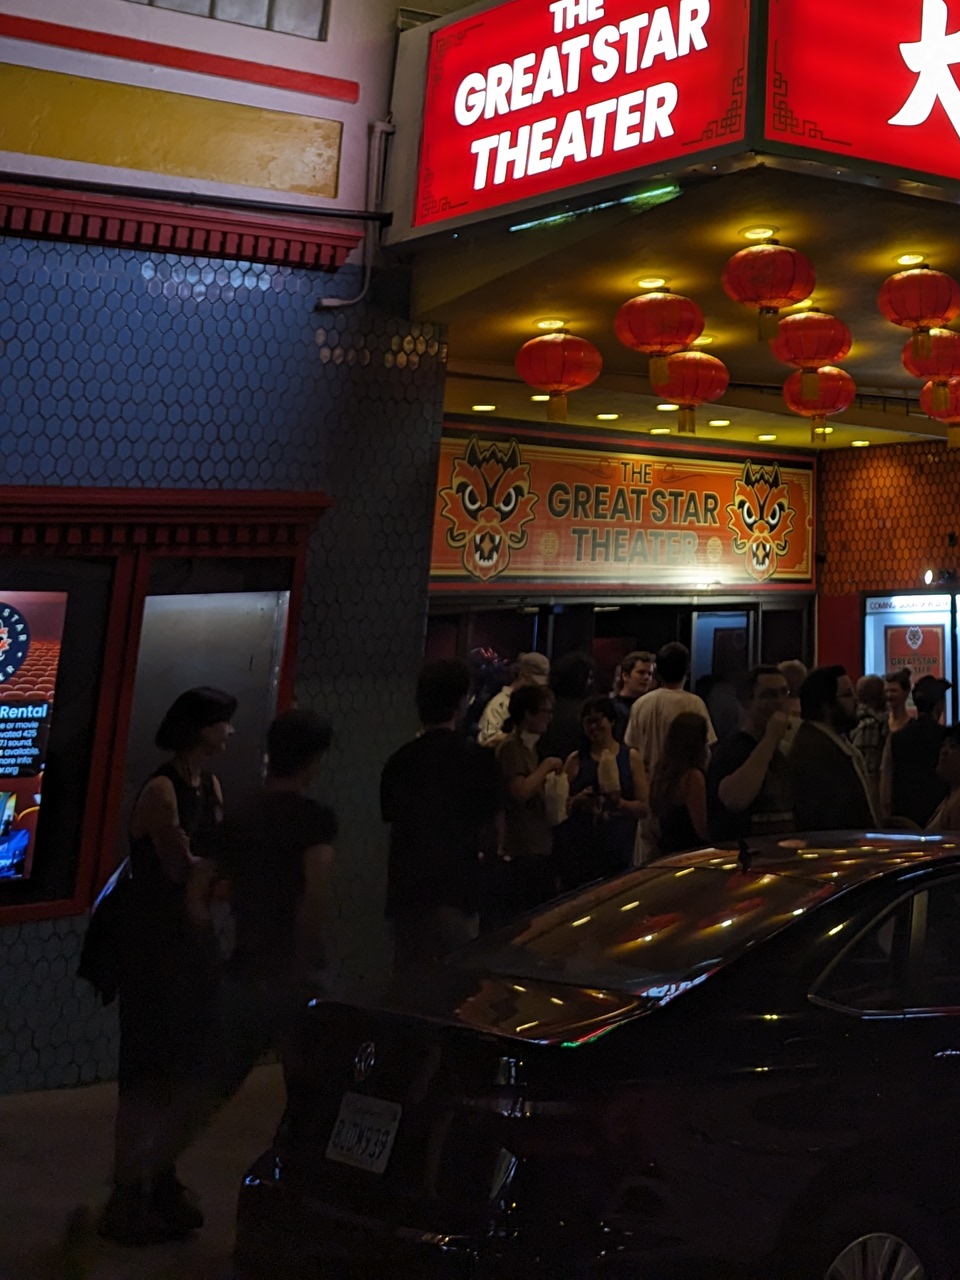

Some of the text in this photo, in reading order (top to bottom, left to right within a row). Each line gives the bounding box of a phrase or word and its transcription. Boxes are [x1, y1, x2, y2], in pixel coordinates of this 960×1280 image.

[454, 34, 590, 126] GREAT
[470, 81, 678, 190] THEATER
[620, 461, 653, 485] THE
[547, 482, 720, 526] GREAT STAR
[571, 526, 699, 565] THEATER
[3, 608, 27, 641] STAR
[890, 657, 914, 666] GREAT
[0, 704, 48, 718] Rental
[15, 720, 39, 729] movie
